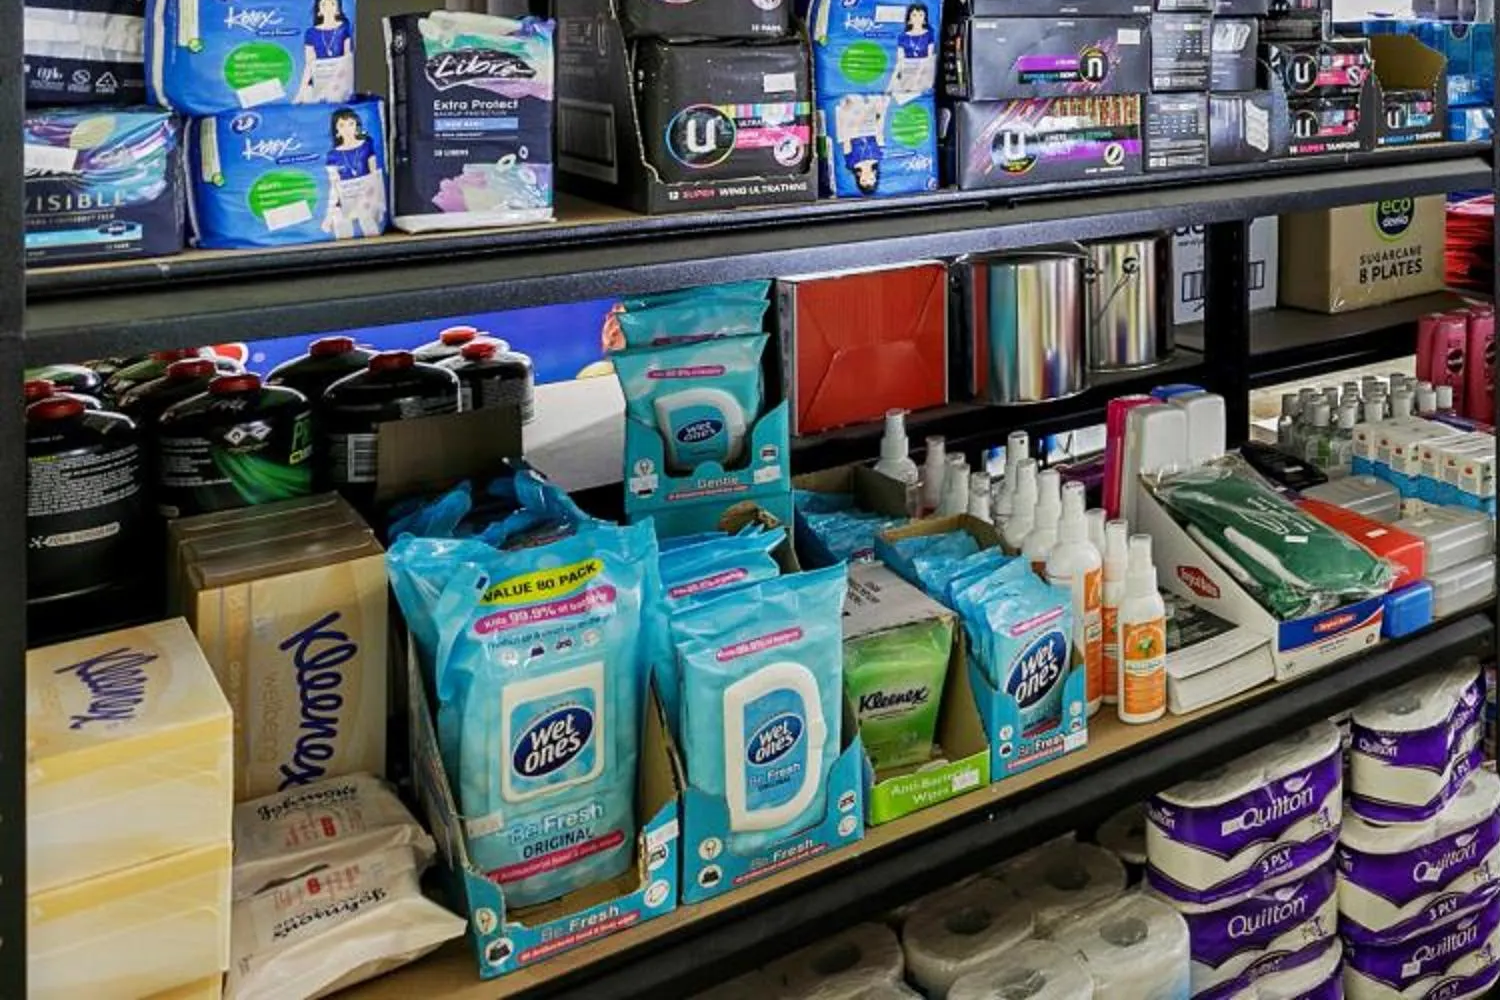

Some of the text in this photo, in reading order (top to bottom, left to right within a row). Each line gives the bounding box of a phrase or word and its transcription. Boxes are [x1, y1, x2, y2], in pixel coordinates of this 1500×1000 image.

[435, 55, 535, 79] Libra
[433, 99, 518, 111] Extra Protect
[1359, 258, 1423, 284] 8 PLATES
[483, 562, 597, 602] VALUE 80 PACK
[508, 606, 557, 622] 99.9%
[1022, 639, 1056, 679] wet
[860, 686, 928, 713] Kleenex
[1016, 659, 1059, 704] ones
[278, 610, 358, 792] Kleenex
[531, 713, 577, 750] wet
[758, 720, 789, 748] wet
[524, 731, 581, 773] ones
[542, 799, 604, 835] Fresh
[1240, 786, 1314, 829] Quilton
[523, 827, 594, 859] ORIGINAL
[1261, 848, 1292, 873] 3 PLY
[1228, 899, 1307, 939] Quilton
[1412, 923, 1478, 963] Quilton
